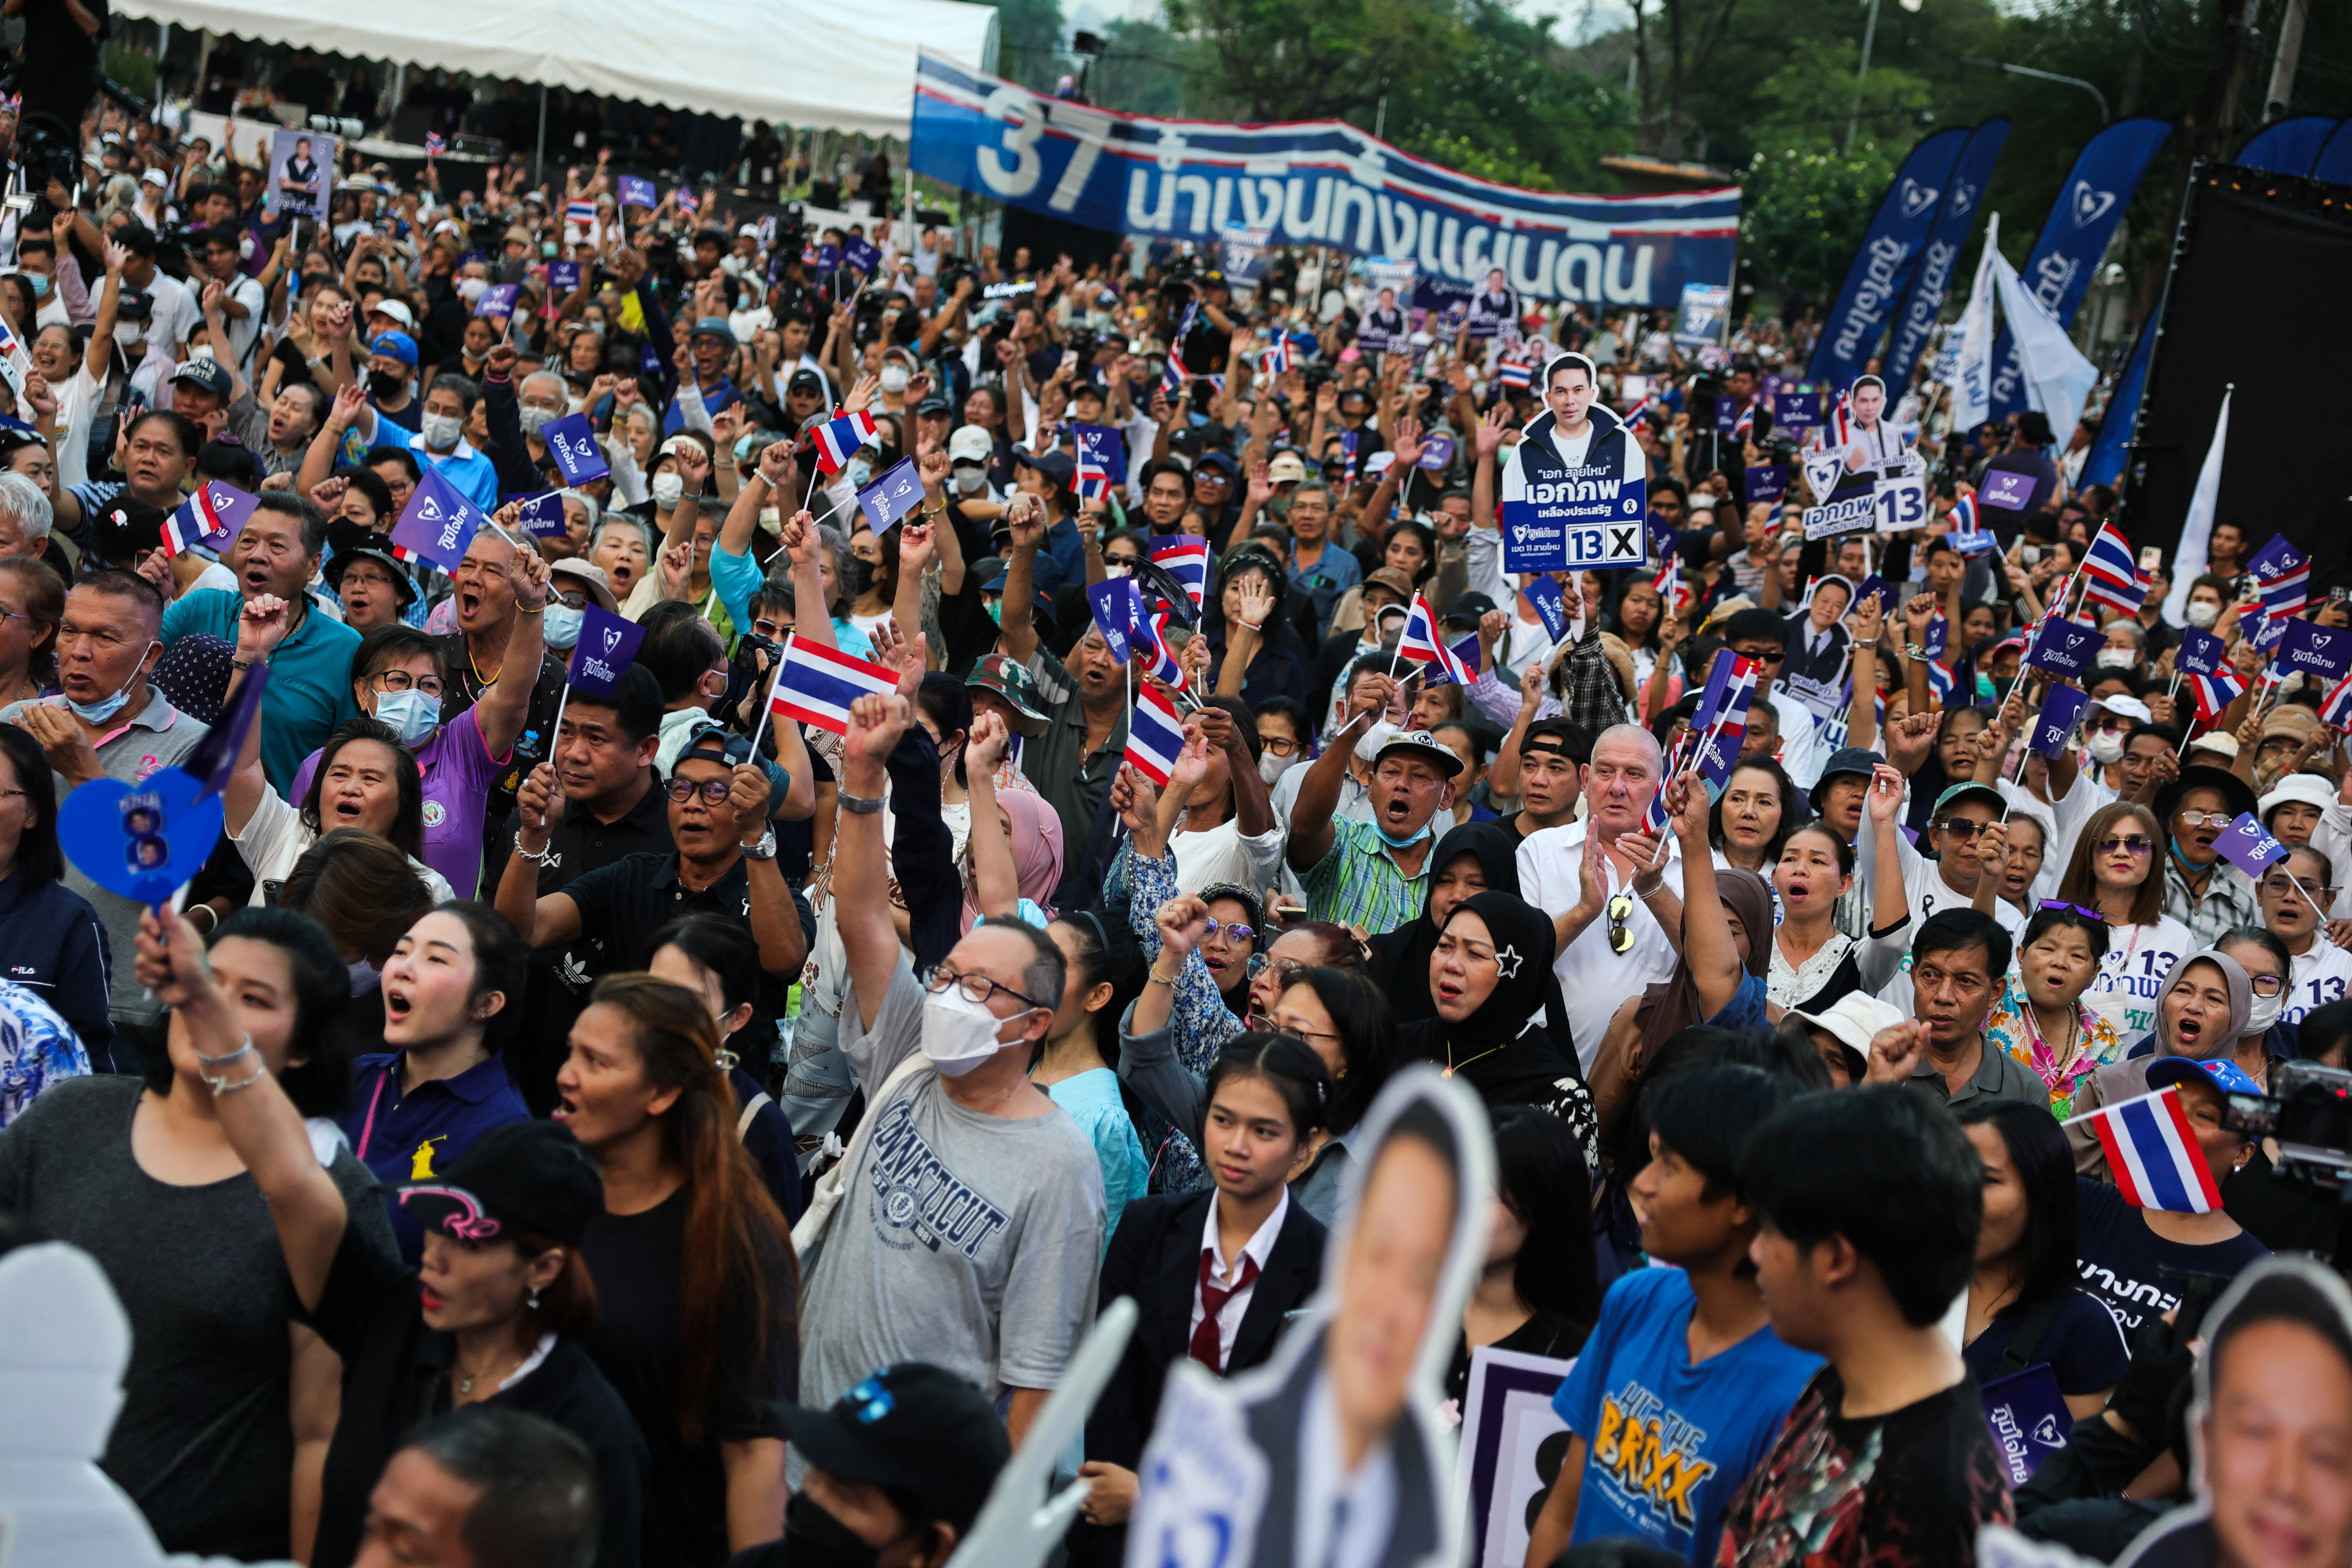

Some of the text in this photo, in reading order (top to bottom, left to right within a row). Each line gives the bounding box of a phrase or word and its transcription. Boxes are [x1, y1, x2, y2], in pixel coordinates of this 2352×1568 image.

[976, 85, 1114, 212] 37
[553, 433, 578, 474] ภูมิใจไทย
[1526, 479, 1621, 505] เอกภพ
[1878, 487, 1924, 523] 13
[871, 493, 891, 522] ภูมิใจไทย
[1538, 504, 1612, 518] เหลืองประเสริฐ
[1805, 496, 1874, 526] เอกภพ
[442, 505, 469, 551] ภูมิใจไทย
[1533, 542, 1561, 551] สายไหม
[1571, 530, 1602, 561] 13
[583, 660, 615, 682] ภูมิใจไทย
[2042, 650, 2078, 668] ภูมิใจไทย
[2292, 651, 2336, 669] ภูมิใจไทย
[1421, 737, 1431, 745] M
[11, 965, 36, 974] FILA
[552, 965, 578, 995] adidas
[2307, 976, 2345, 1004] 13
[915, 1224, 933, 1244] 1881
[1662, 1408, 1707, 1461] THE
[1991, 1406, 2028, 1483] ภูมิใจไทย
